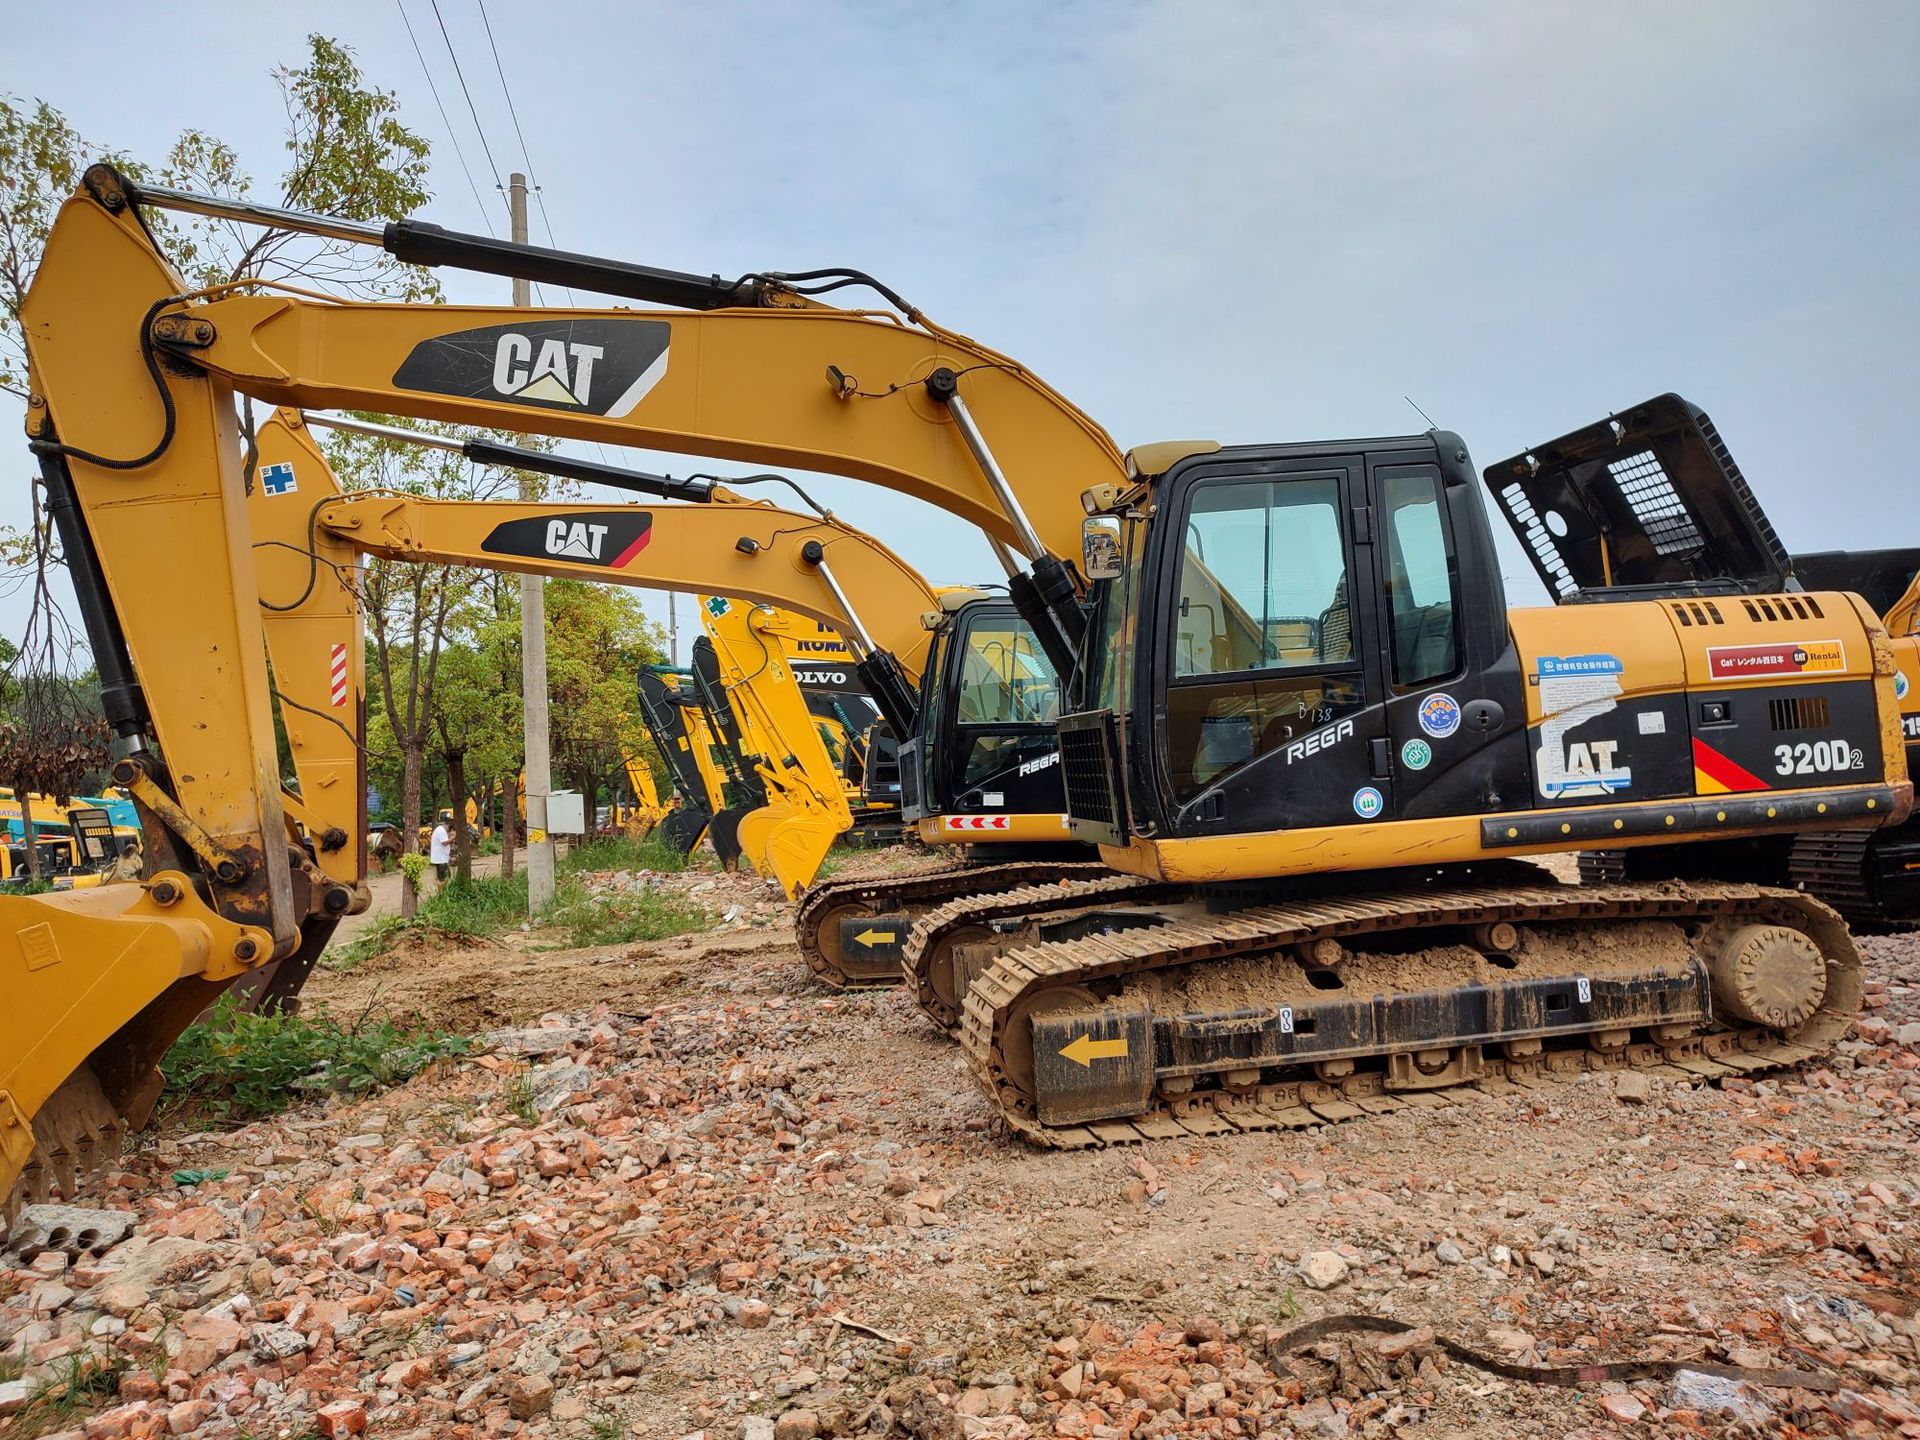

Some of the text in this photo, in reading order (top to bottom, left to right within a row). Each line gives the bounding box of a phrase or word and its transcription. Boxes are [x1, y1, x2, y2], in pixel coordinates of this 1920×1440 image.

[493, 333, 604, 405] CAT
[545, 519, 608, 560] CAT
[1794, 653, 1806, 662] CAT
[1810, 652, 1840, 661] Rental
[793, 671, 847, 684] OLVO
[1287, 719, 1354, 765] REGA
[1019, 752, 1061, 777] REGA
